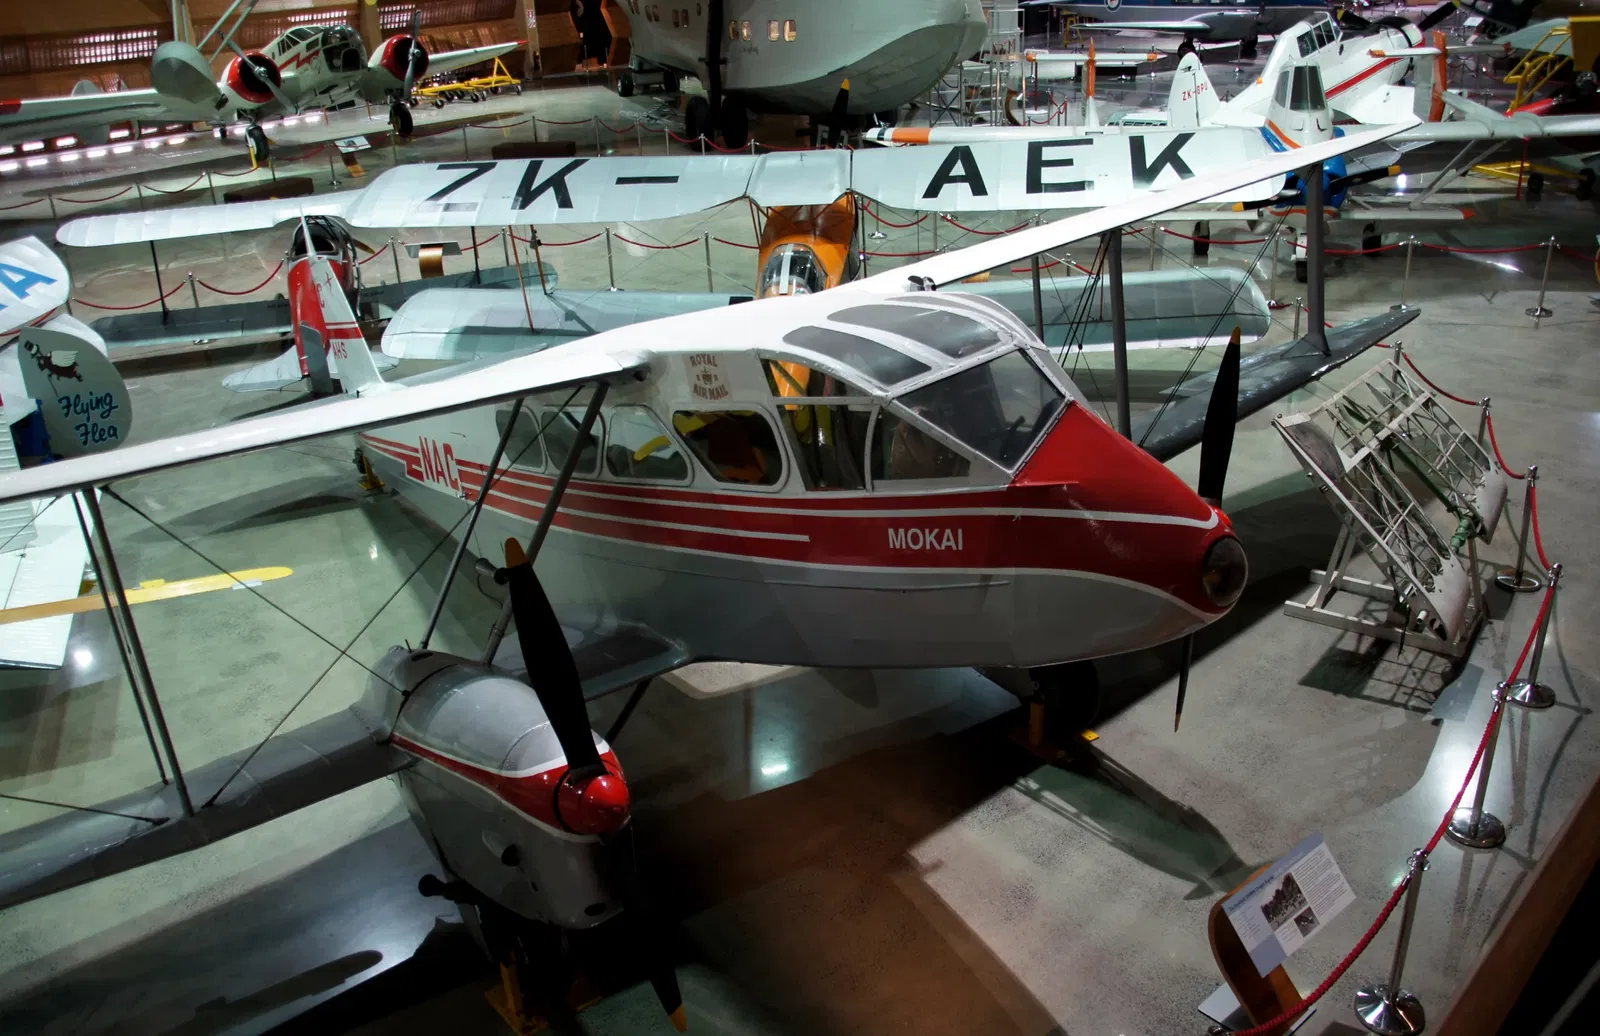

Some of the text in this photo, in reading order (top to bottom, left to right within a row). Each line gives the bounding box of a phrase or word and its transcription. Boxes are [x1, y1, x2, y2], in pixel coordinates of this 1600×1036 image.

[332, 341, 348, 360] AHS
[689, 353, 718, 368] ROYAL
[693, 383, 729, 400] AIR MAIL
[58, 391, 119, 423] Flying
[74, 422, 119, 446] Flea
[419, 436, 460, 492] NAC
[888, 528, 963, 551] MOKAI
